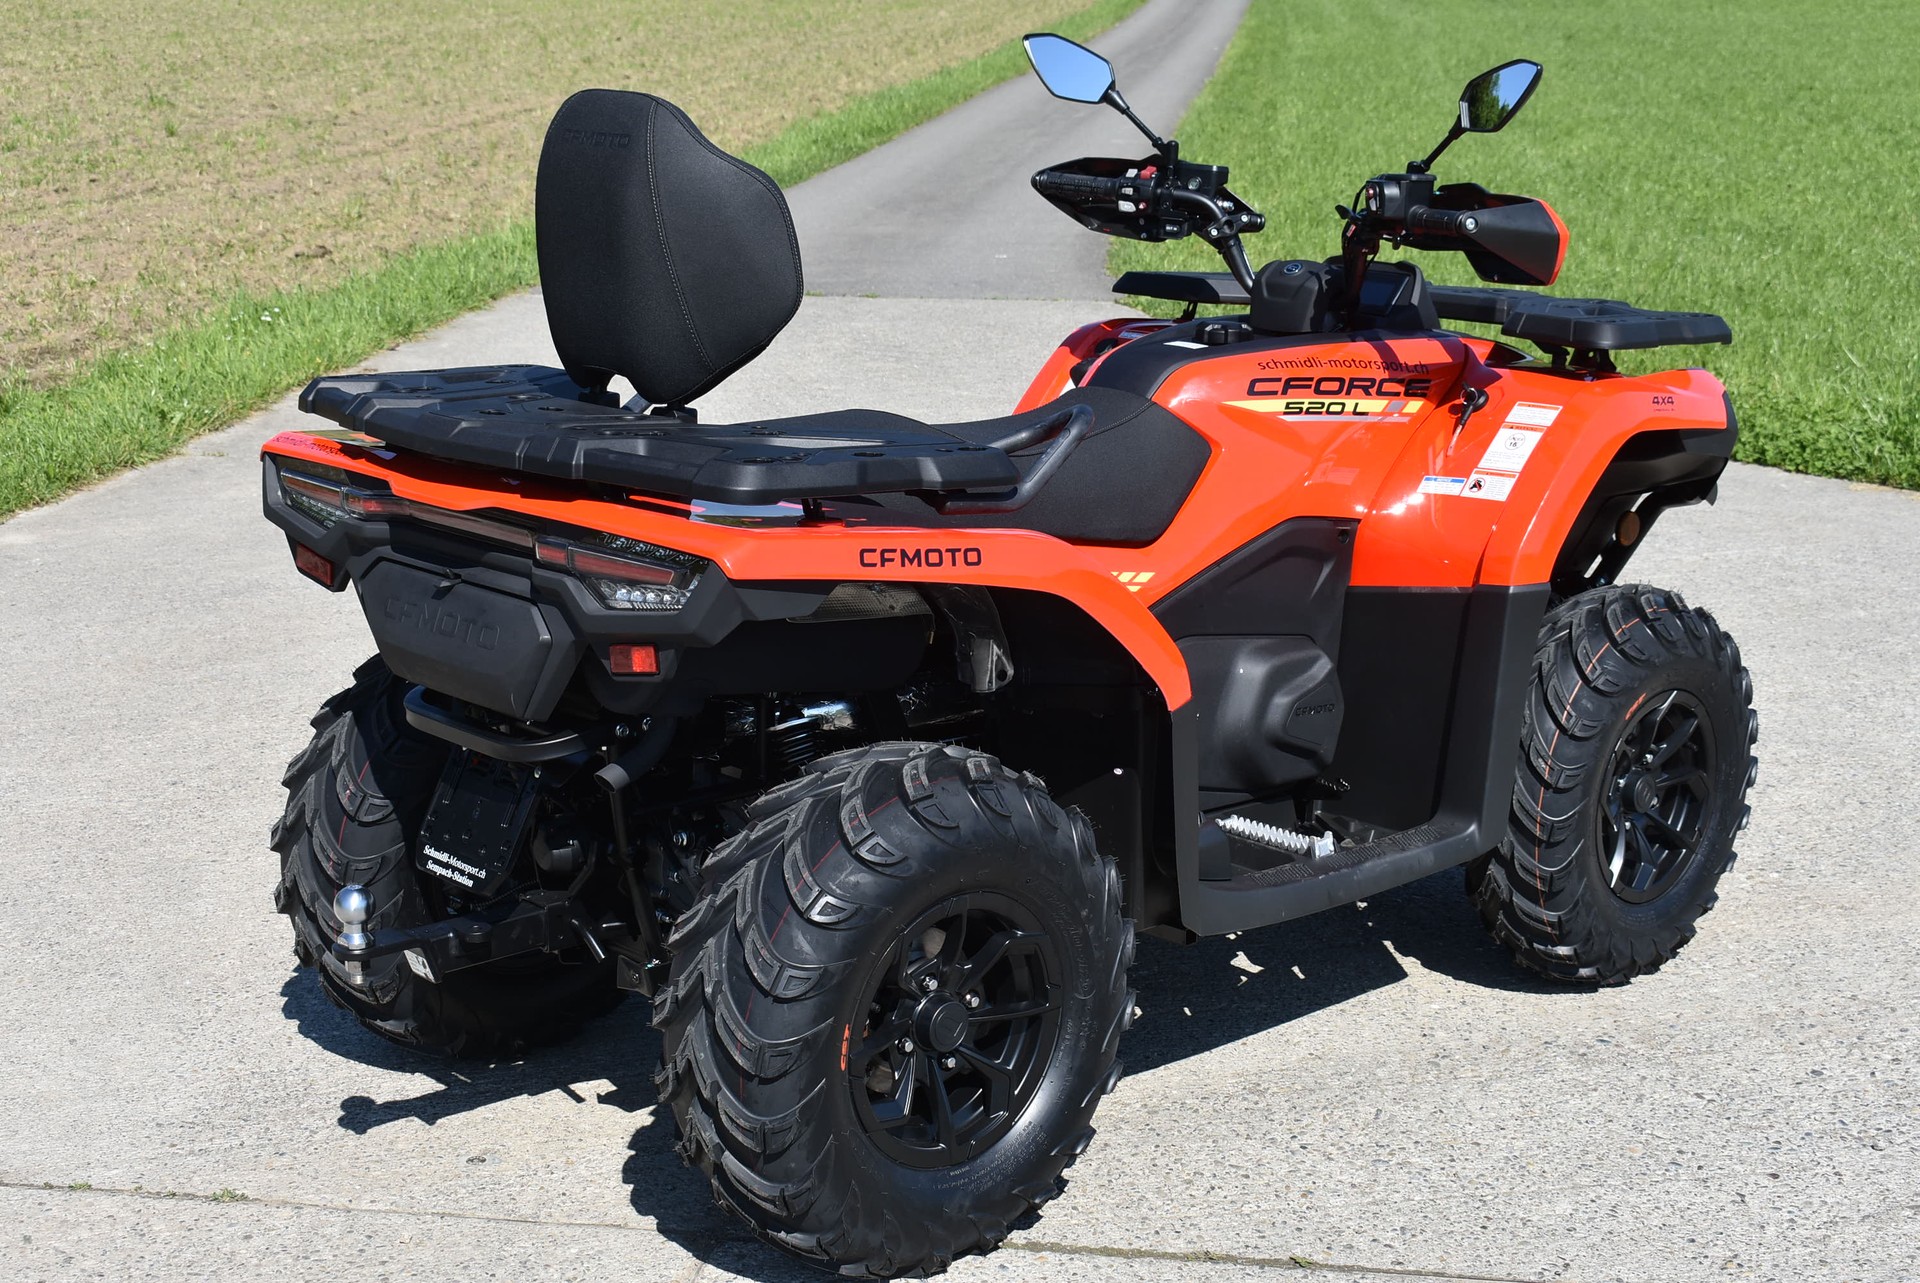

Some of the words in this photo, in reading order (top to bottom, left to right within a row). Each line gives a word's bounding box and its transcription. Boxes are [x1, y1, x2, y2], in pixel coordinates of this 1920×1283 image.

[1257, 356, 1430, 375] schmidli-motorsport.ch
[1246, 377, 1432, 397] CFORCE
[1283, 402, 1346, 416] 520
[1352, 402, 1370, 416] L
[859, 547, 982, 568] CFMOTO
[384, 597, 501, 651] CFMOTO
[423, 844, 487, 879] Schmidli-Motorsport.ch
[426, 859, 474, 888] Sempach-Station
